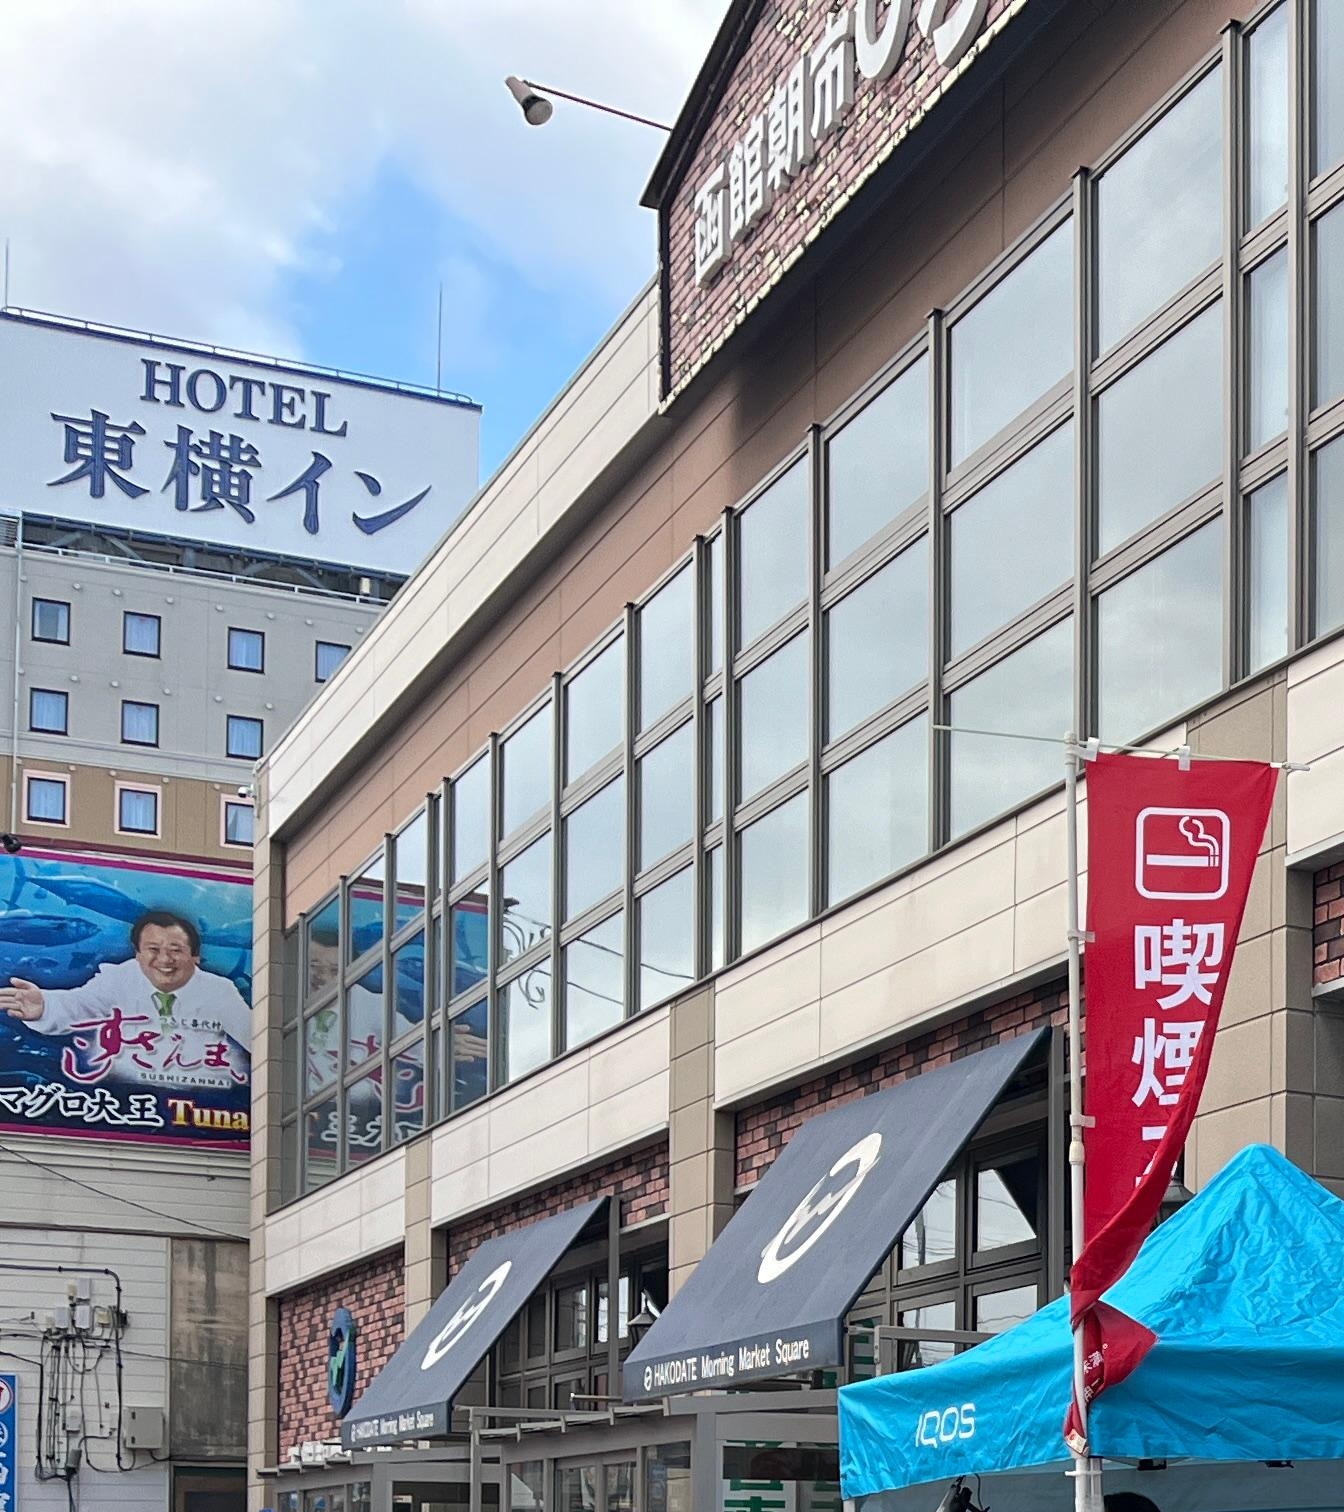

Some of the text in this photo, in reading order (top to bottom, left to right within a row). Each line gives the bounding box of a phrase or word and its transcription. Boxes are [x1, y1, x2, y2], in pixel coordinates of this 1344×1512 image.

[140, 358, 349, 438] HOTEL
[46, 408, 433, 536] 東横イン
[1131, 918, 1225, 1190] 喫煙
[0, 1083, 249, 1131] マグロ大王 Tuna
[654, 1338, 810, 1387] HAKODATE Morning Market Square
[915, 1402, 976, 1449] IQOS
